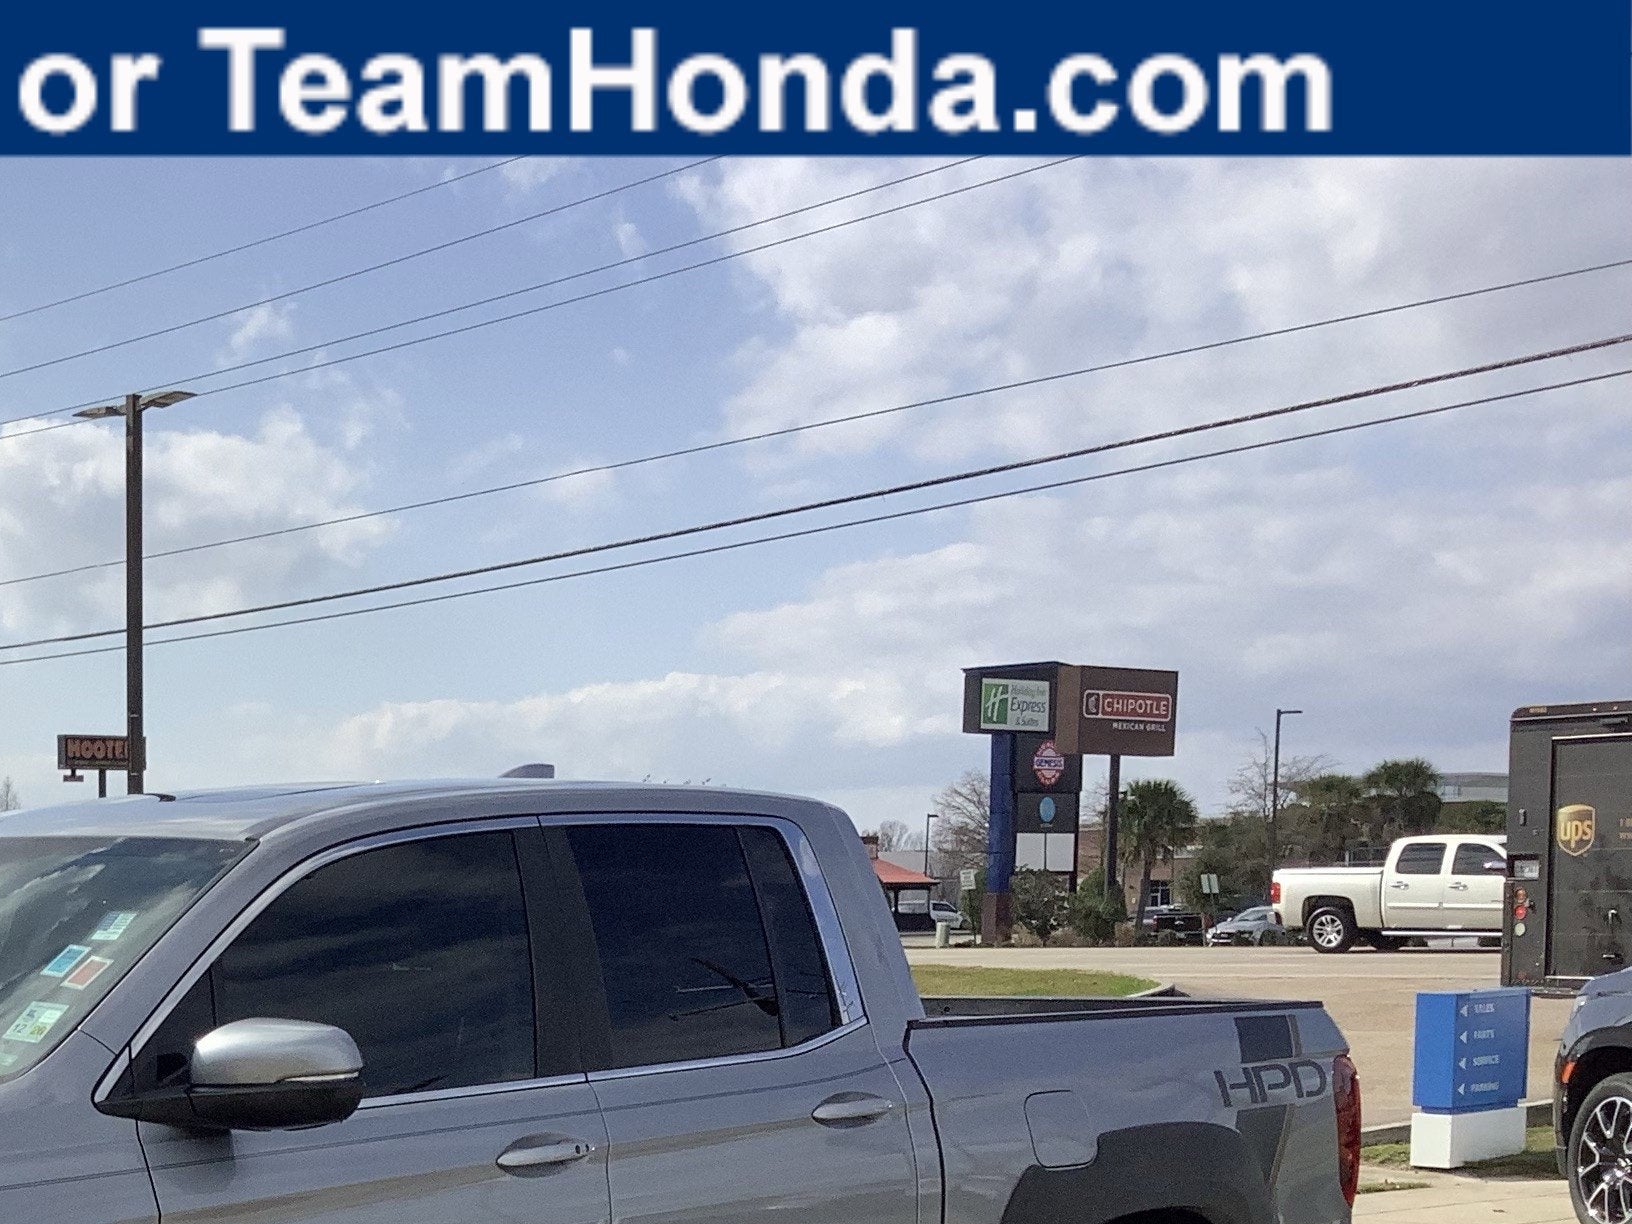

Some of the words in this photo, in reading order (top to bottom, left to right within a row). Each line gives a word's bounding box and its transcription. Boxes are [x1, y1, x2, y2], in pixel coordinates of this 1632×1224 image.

[1010, 697, 1047, 716] Express
[1104, 698, 1168, 715] CHIPOTLE
[1112, 721, 1145, 731] MEXICAN
[1146, 723, 1166, 732] GRILL
[67, 739, 129, 759] HOOTE
[1035, 758, 1063, 768] GENESIS
[1560, 820, 1592, 848] ups
[1213, 1059, 1328, 1108] HPD
